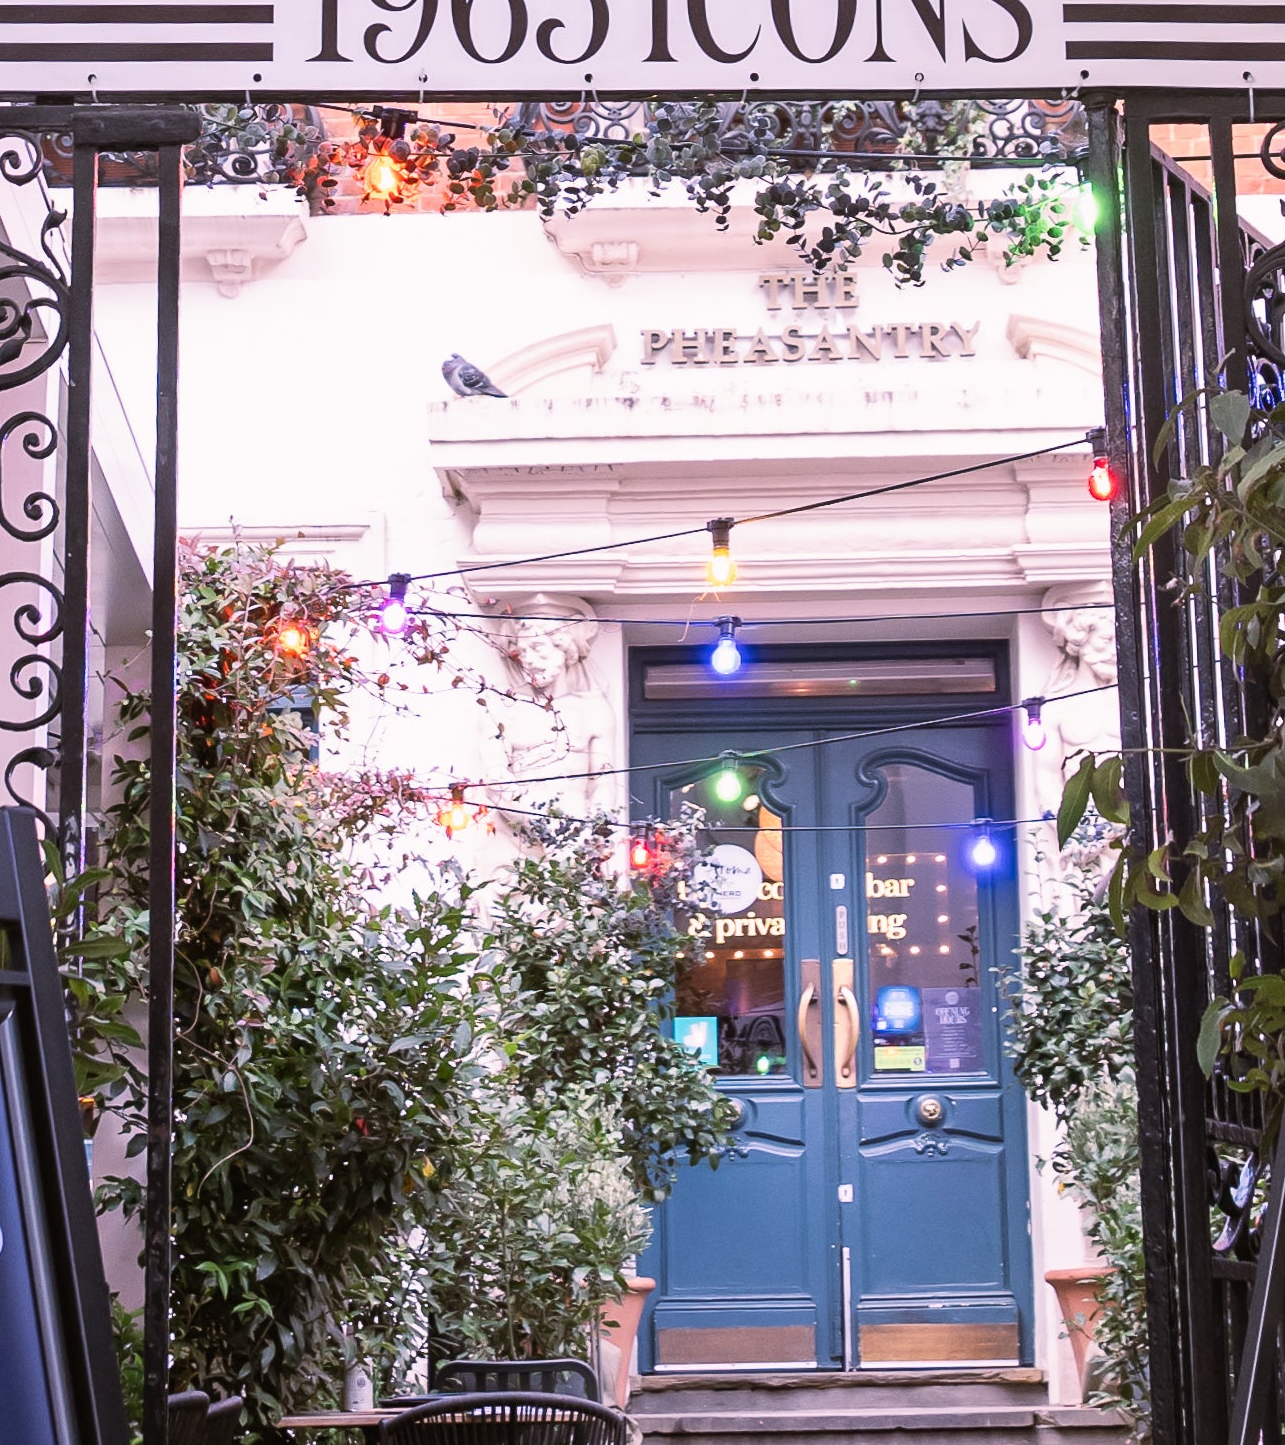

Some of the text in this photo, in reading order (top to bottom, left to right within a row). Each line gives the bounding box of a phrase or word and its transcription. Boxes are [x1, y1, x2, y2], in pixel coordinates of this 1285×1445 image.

[759, 273, 858, 310] THE
[641, 320, 980, 365] PHEASANTRY
[866, 872, 915, 898] bar
[716, 911, 785, 944] priva
